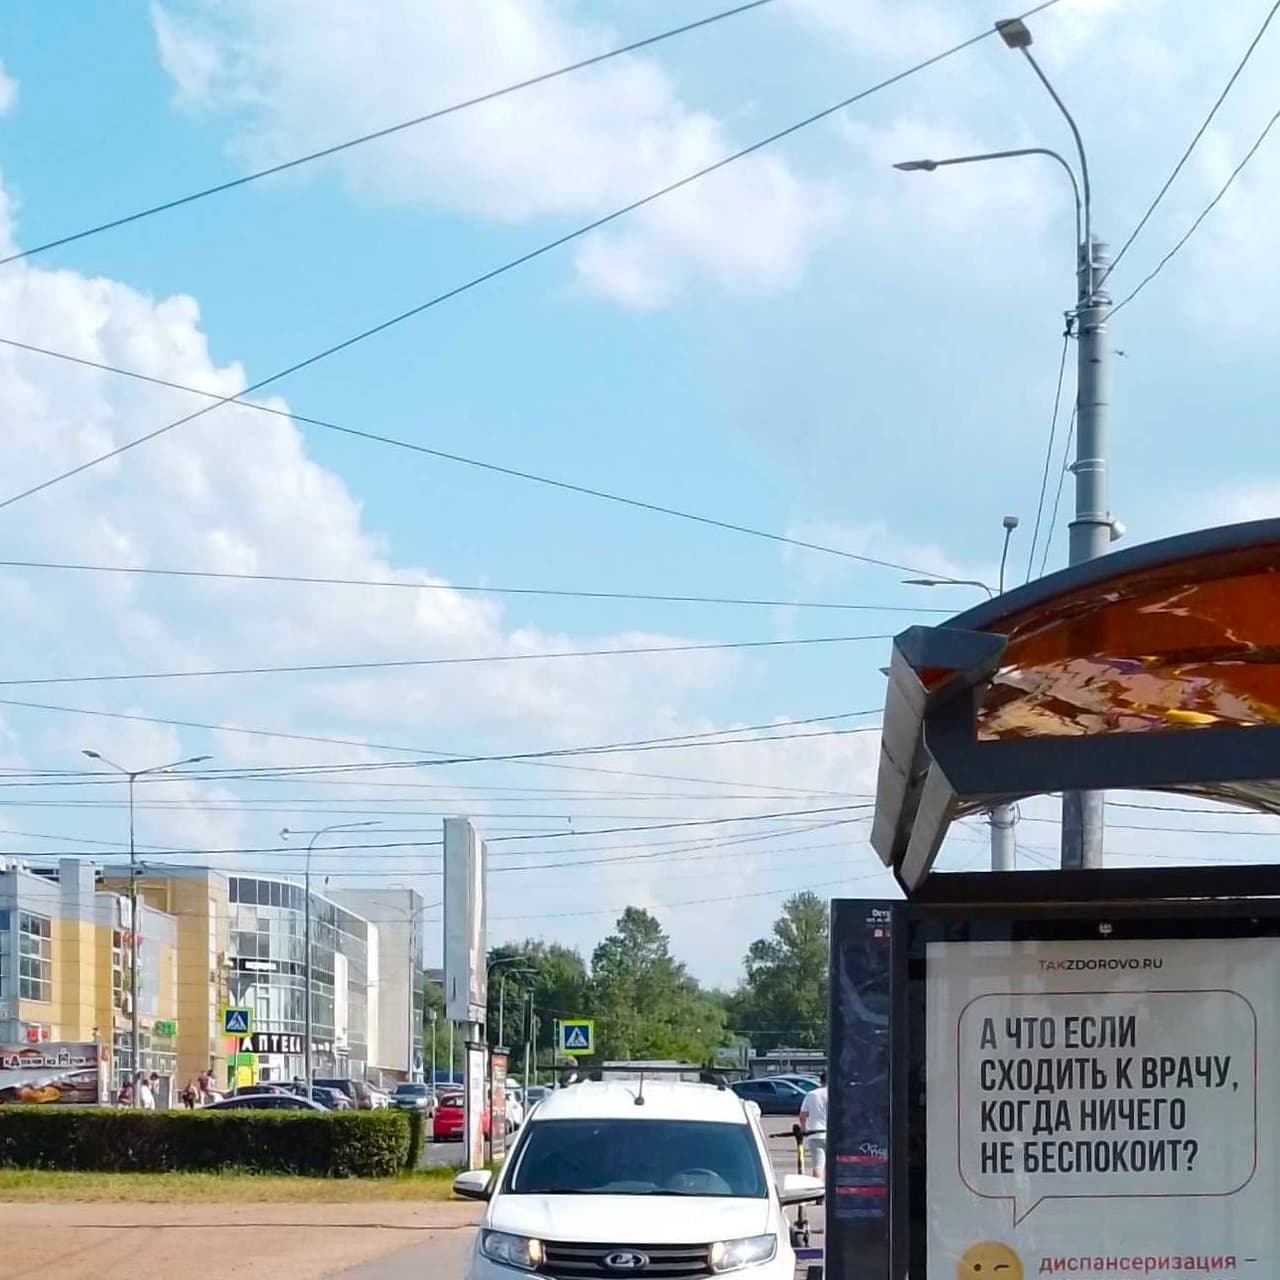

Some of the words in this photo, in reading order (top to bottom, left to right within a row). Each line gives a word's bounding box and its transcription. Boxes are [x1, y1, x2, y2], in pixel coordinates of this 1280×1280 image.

[1038, 957, 1163, 971] TAKZDOROVO.RU
[980, 1016, 998, 1050] А
[1005, 1016, 1056, 1050] ЧТО
[1064, 1015, 1137, 1049] ЕСЛИ
[979, 1056, 1108, 1095] СХОДИТЬ
[1116, 1057, 1134, 1090] К
[1141, 1055, 1240, 1093] ВРАЧУ,
[980, 1099, 1072, 1136] КОГДА
[1080, 1097, 1187, 1132] НИЧЕГО
[980, 1140, 1015, 1174] НЕ
[1022, 1138, 1199, 1174] БЕСПОКОИТ?
[1038, 1255, 1237, 1275] диспансеризация
